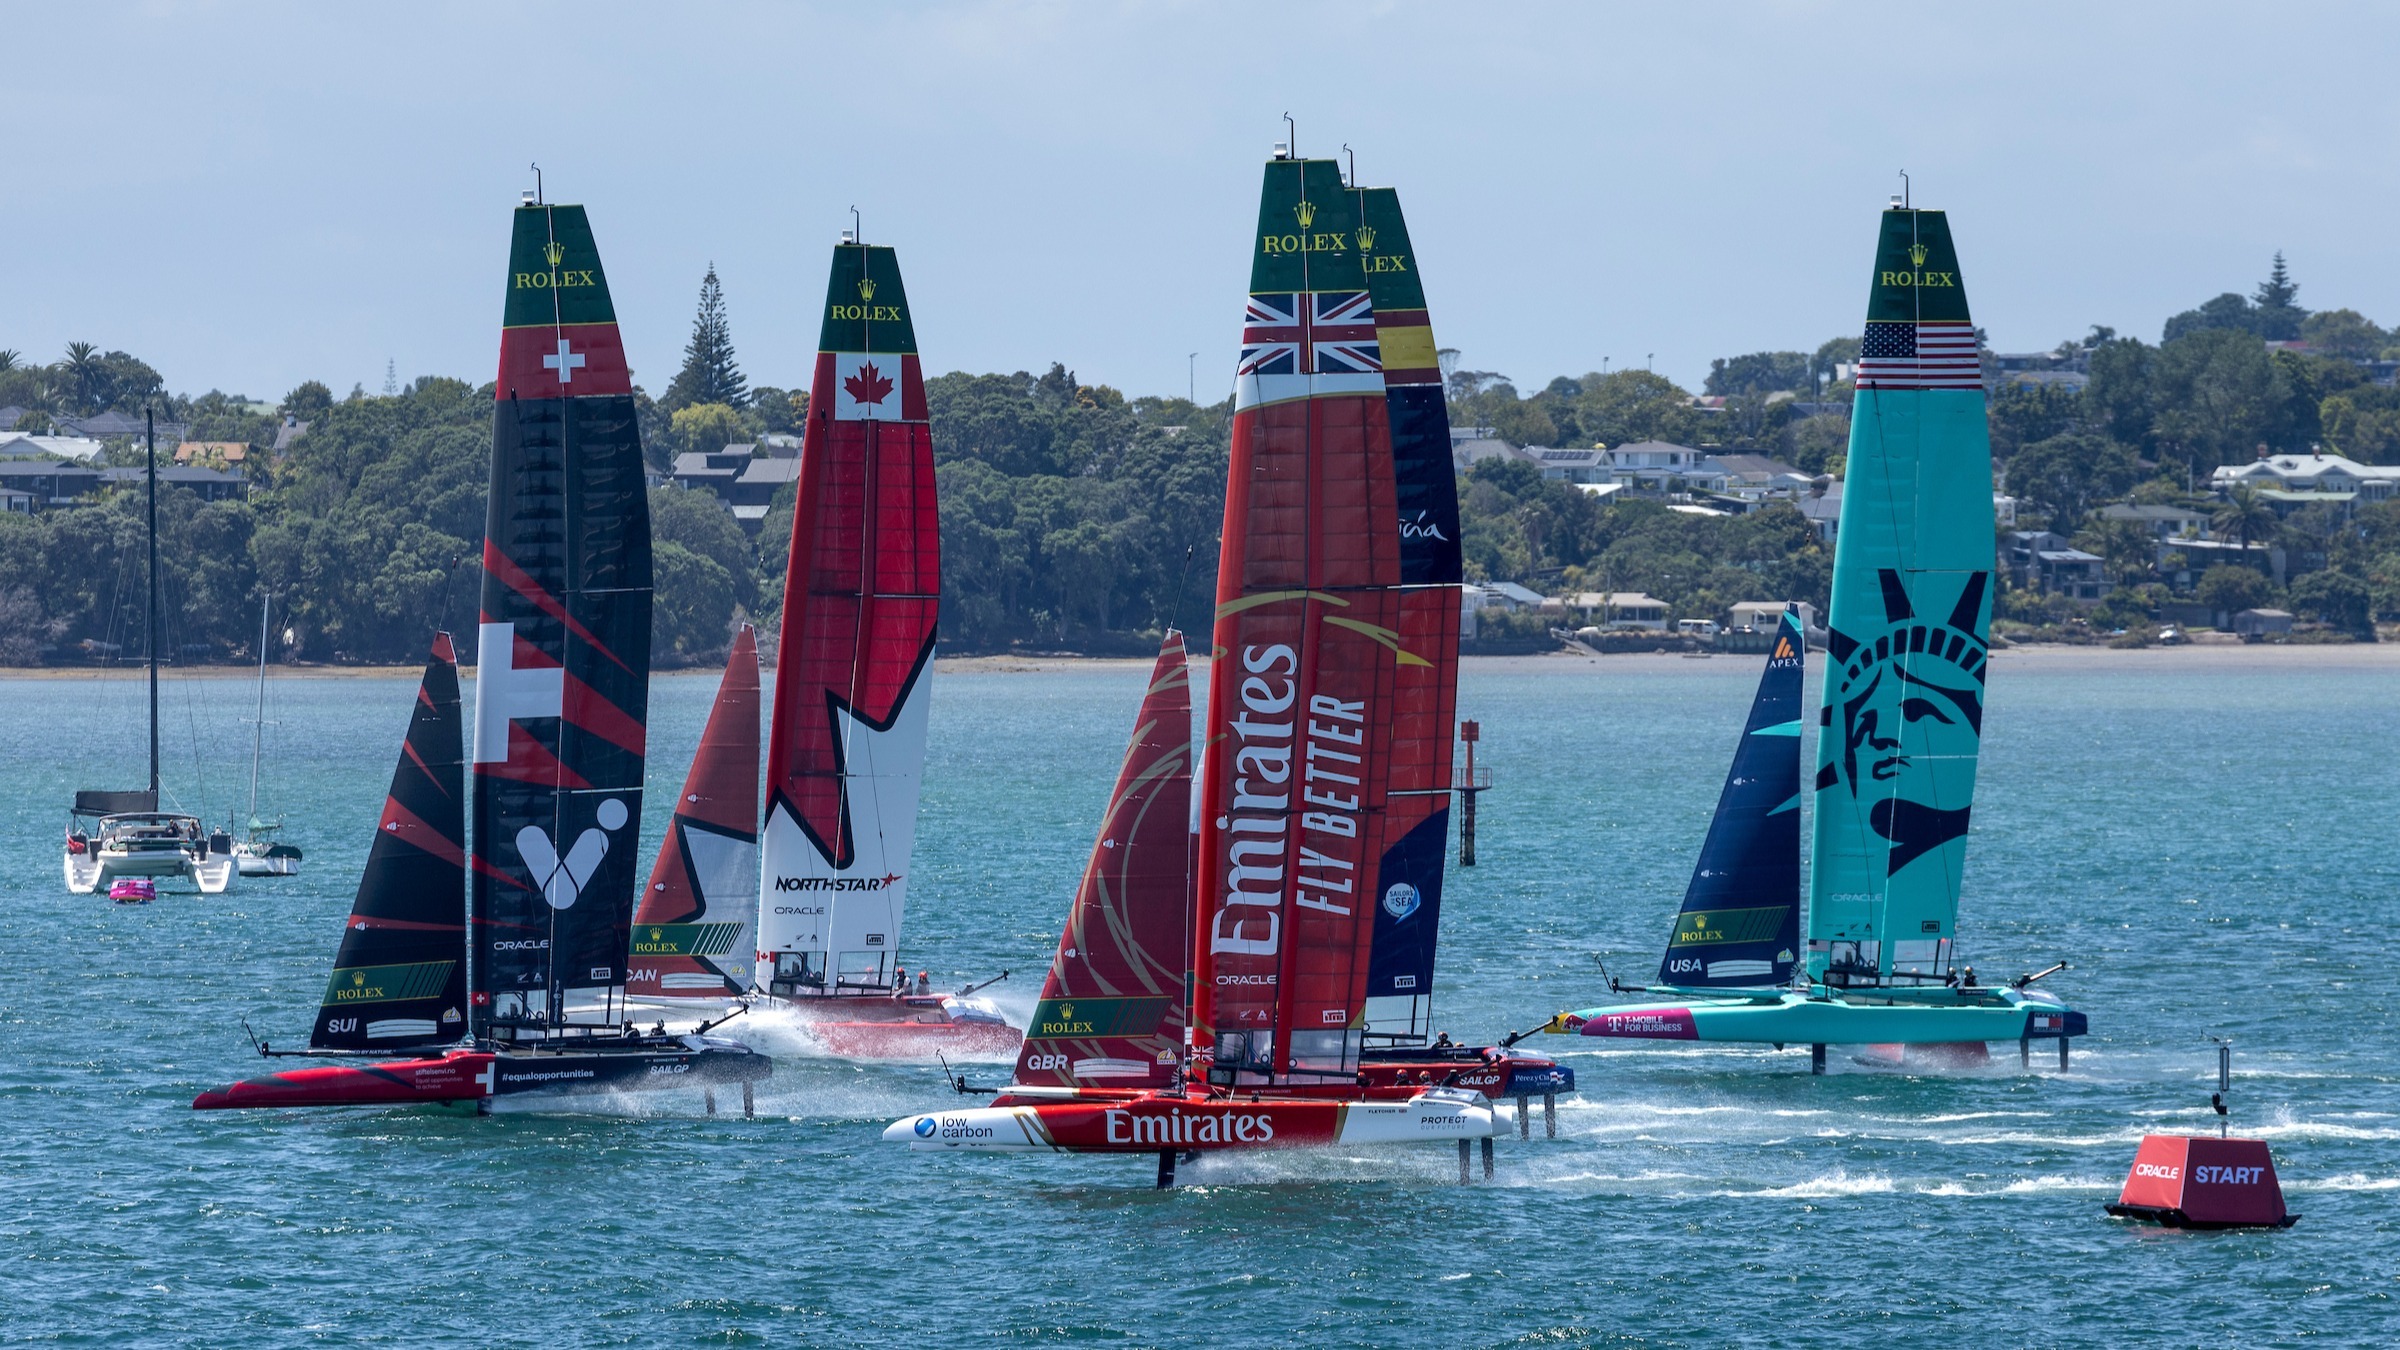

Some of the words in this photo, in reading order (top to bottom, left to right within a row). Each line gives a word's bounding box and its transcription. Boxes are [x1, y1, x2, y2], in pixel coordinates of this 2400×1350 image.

[1263, 233, 1347, 253] ROLEX
[1361, 255, 1407, 273] LEX
[515, 270, 595, 288] ROLEX
[1881, 271, 1954, 287] ROLEX
[831, 305, 901, 320] ROLEX
[1769, 658, 1799, 668] APEX
[1301, 694, 1365, 838] BETTER
[1210, 643, 1298, 957] Emirates
[774, 875, 880, 893] NORTHSTAR
[1296, 846, 1354, 916] FLY
[1395, 897, 1413, 907] SEA
[1832, 893, 1883, 902] ORACLE
[774, 907, 825, 915] ORACLE
[1681, 931, 1723, 942] ROLEX
[493, 939, 549, 950] ORACLE
[635, 943, 678, 952] ROLEX
[1670, 959, 1702, 973] USA
[625, 969, 657, 981] CAN
[1216, 975, 1277, 985] ORACLE
[337, 987, 384, 1000] ROLEX
[328, 1018, 357, 1033] SUI
[1624, 1016, 1663, 1024] T-MOBILE
[1042, 1022, 1093, 1033] ROLEX
[1625, 1024, 1641, 1032] FOR
[1642, 1023, 1682, 1032] BUSINESS
[1027, 1055, 1068, 1070] GBR
[502, 1069, 594, 1082] #equalopportunities
[942, 1116, 967, 1127] low
[1105, 1107, 1274, 1143] Emirates
[1421, 1116, 1467, 1124] PROTECT
[942, 1125, 993, 1138] carbon
[2136, 1163, 2179, 1180] ORACLE
[2195, 1165, 2264, 1185] START
